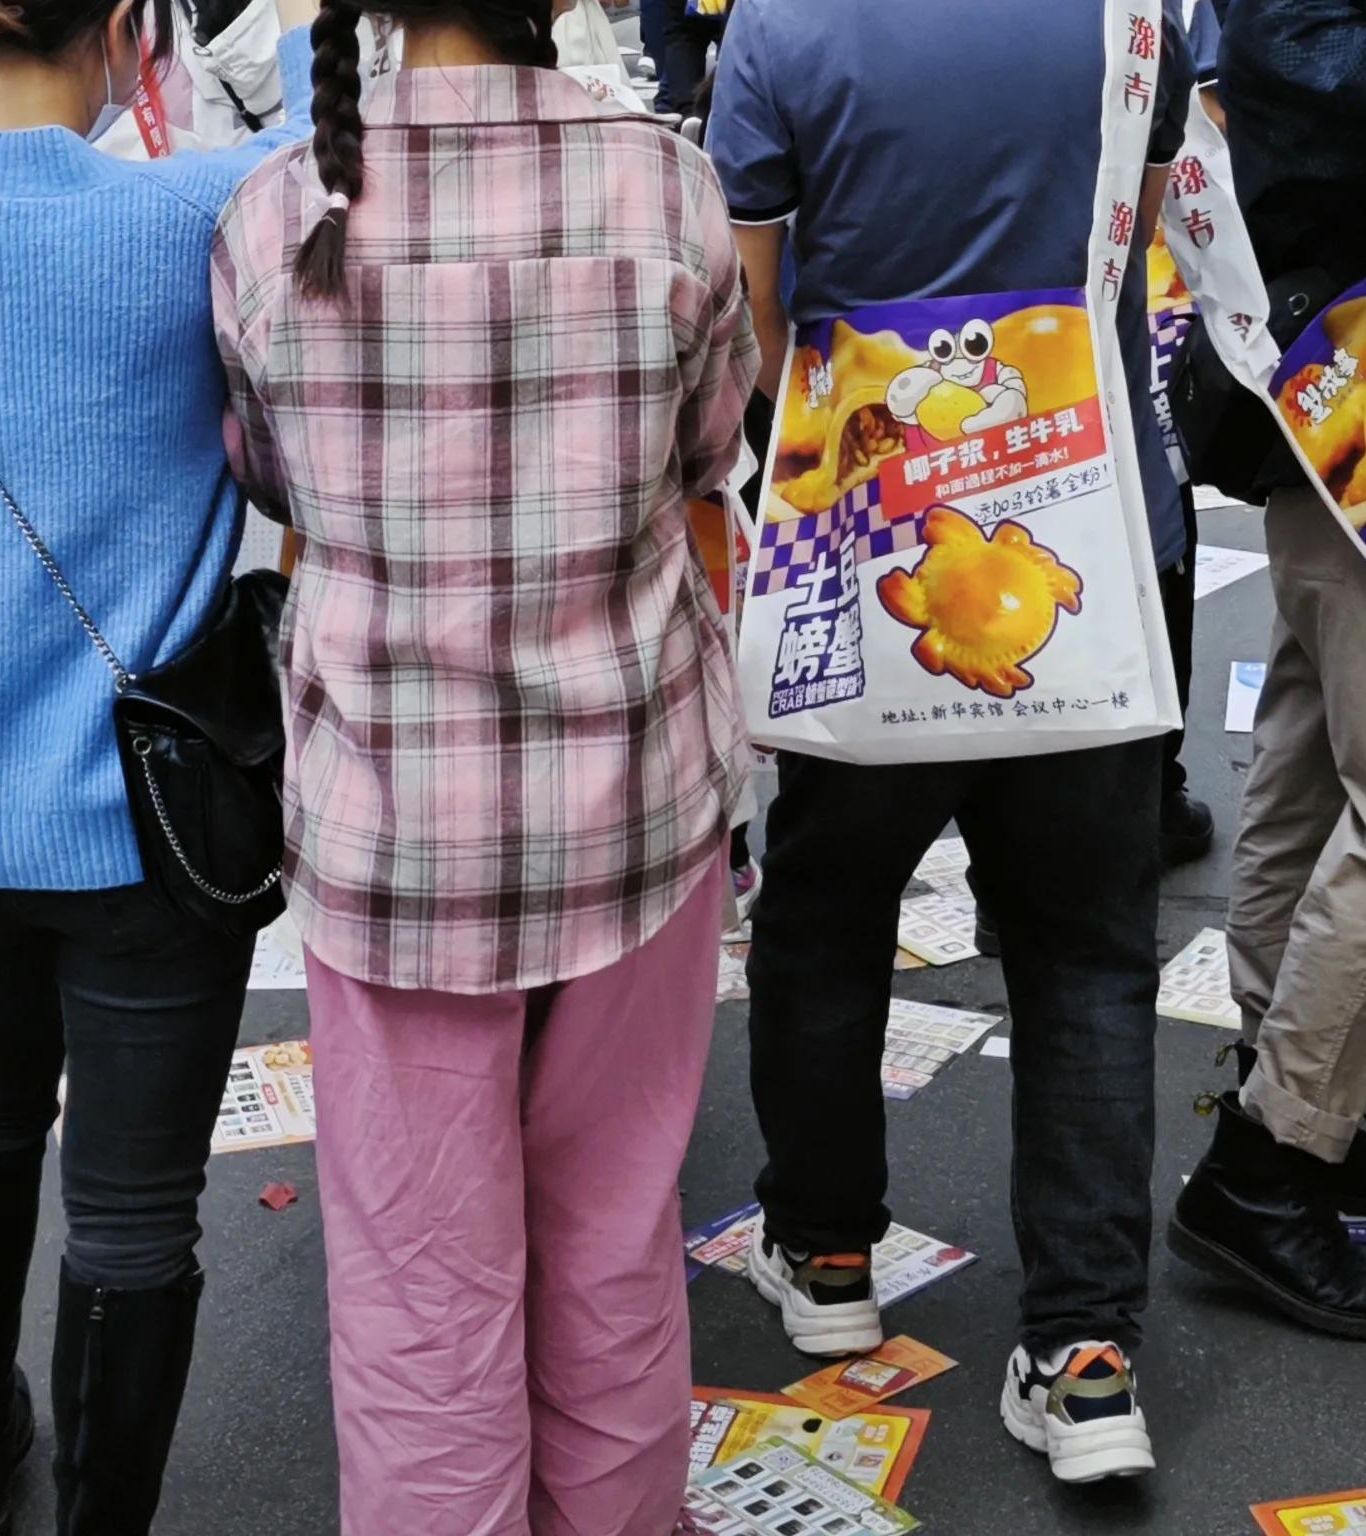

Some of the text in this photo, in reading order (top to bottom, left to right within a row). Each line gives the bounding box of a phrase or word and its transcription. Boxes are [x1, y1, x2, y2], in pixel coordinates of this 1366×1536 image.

[1123, 12, 1157, 118] 豫吉
[1169, 153, 1216, 252] 豫吉
[1100, 198, 1135, 303] 豫吉
[785, 530, 860, 620] 土豆
[773, 602, 864, 687] 螃蟹
[770, 695, 804, 716] CRAB
[1011, 690, 1131, 718] 会议中心一楼
